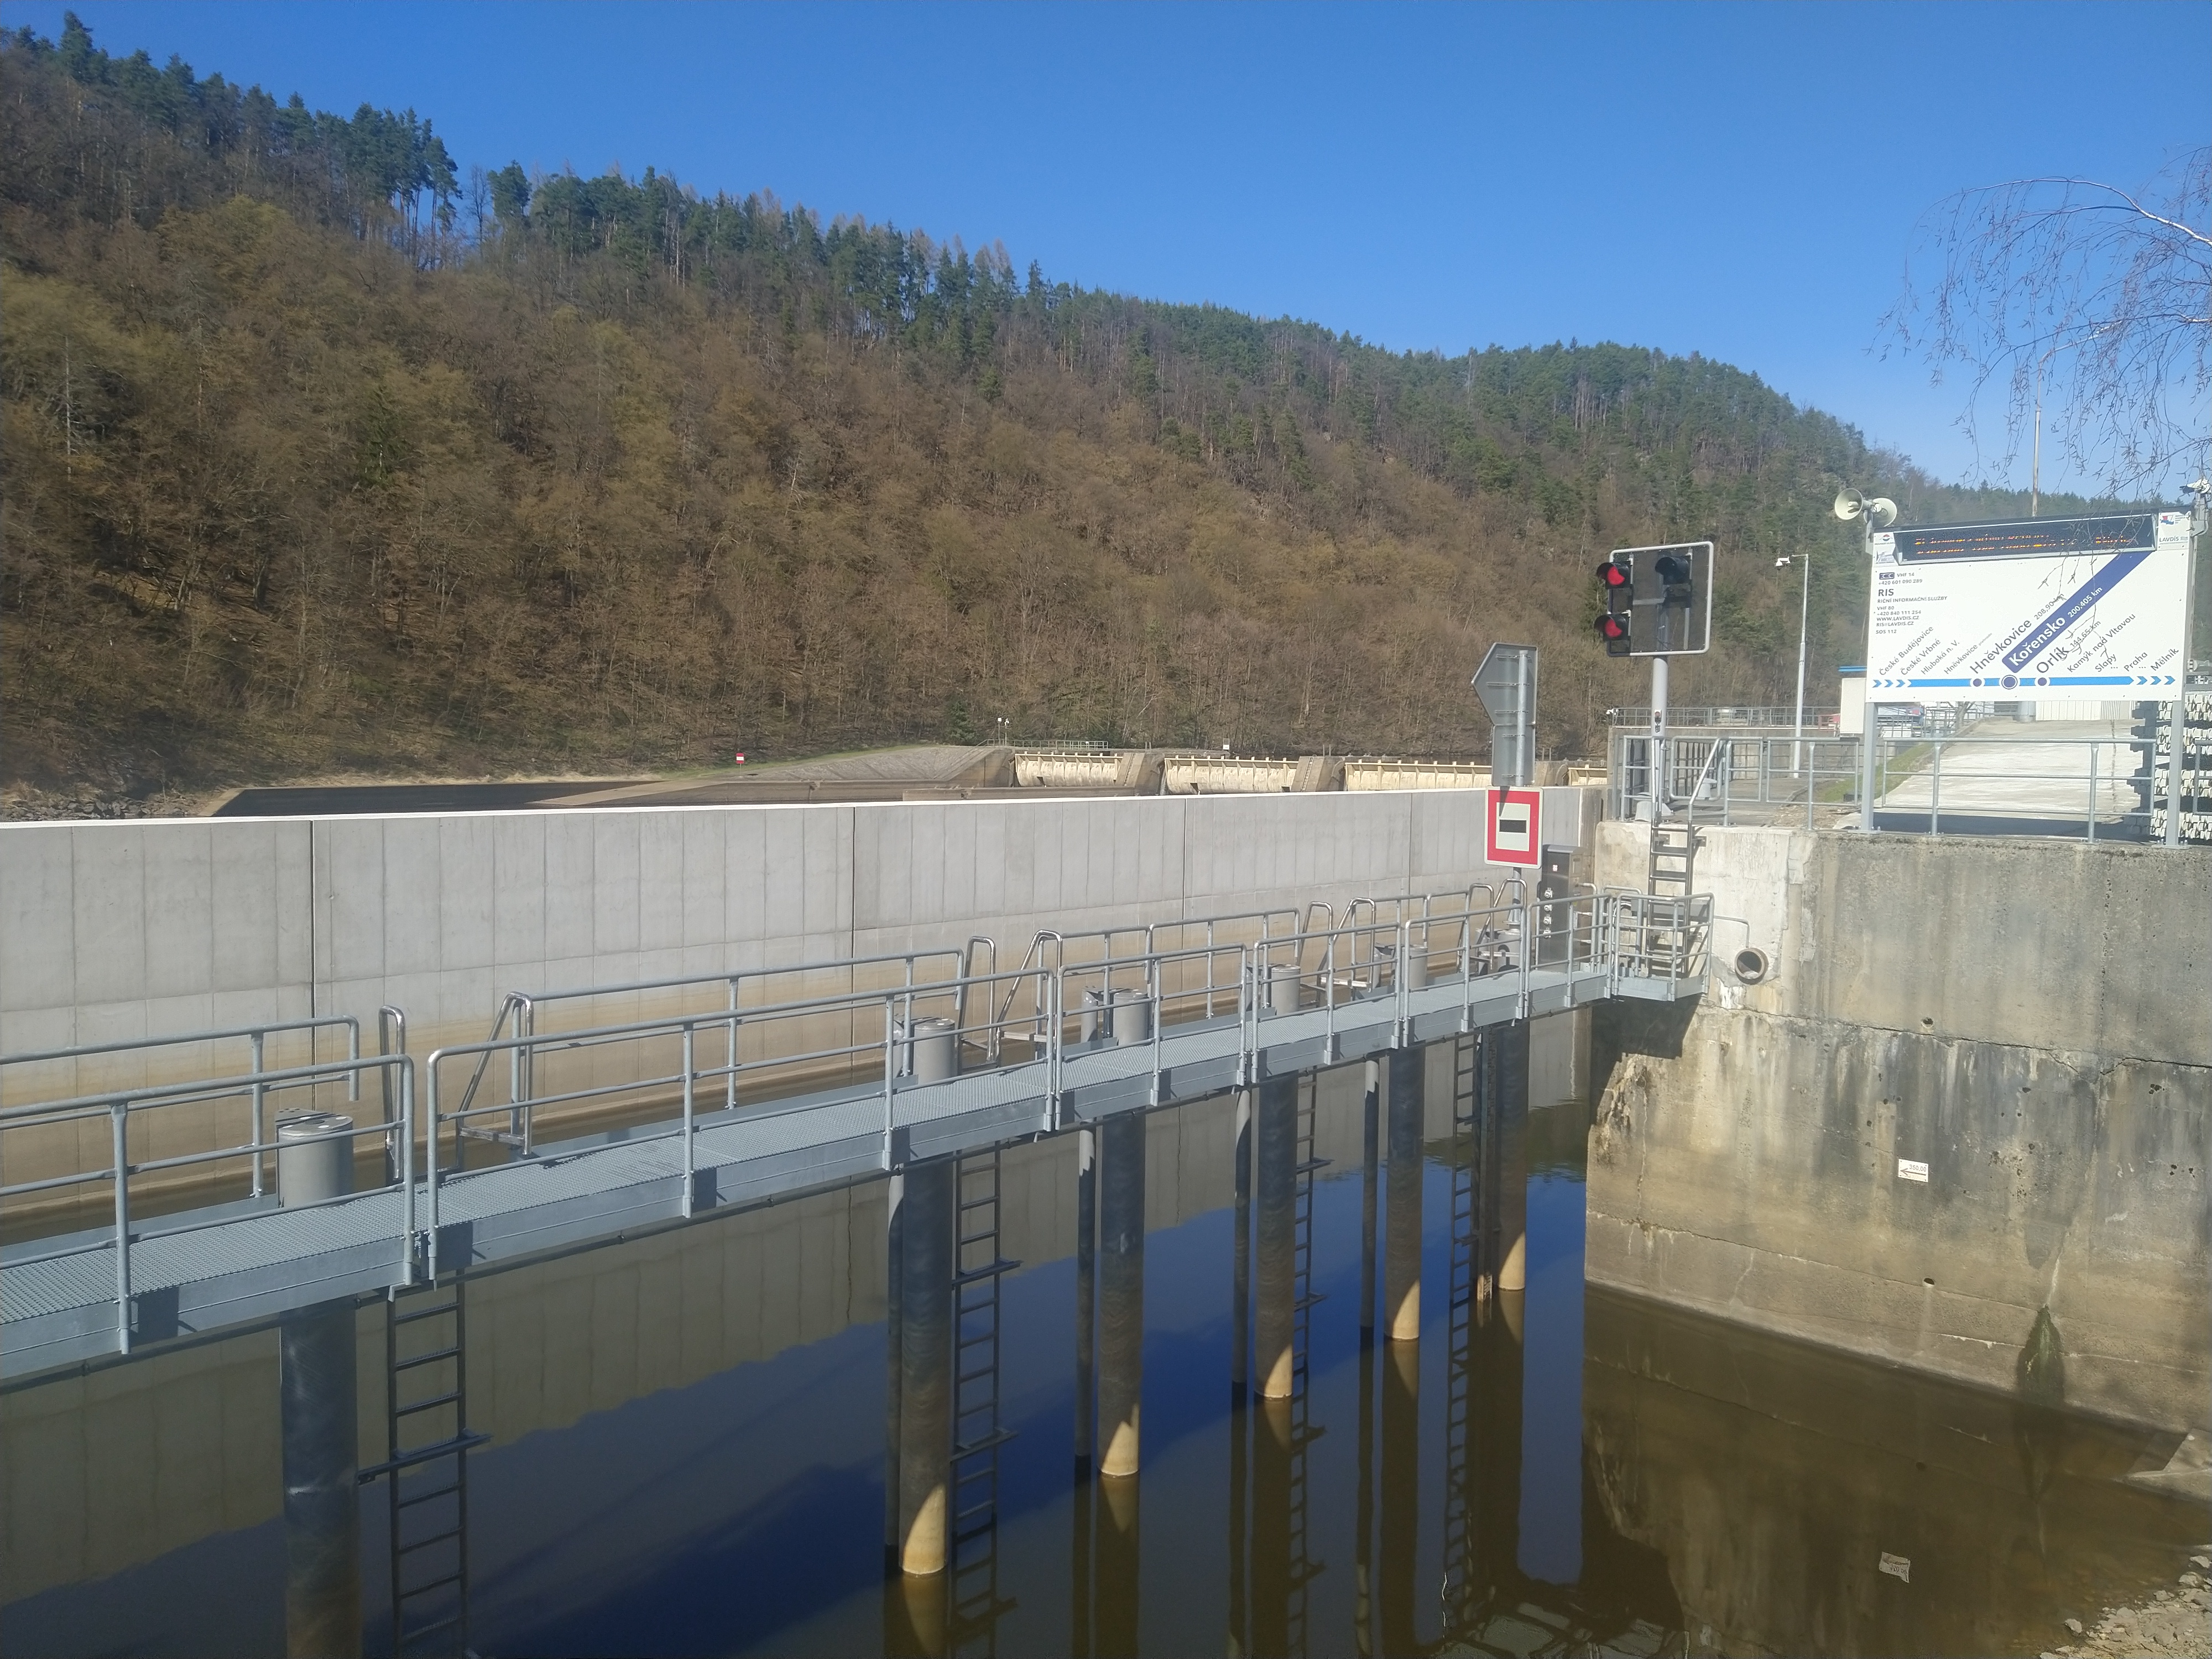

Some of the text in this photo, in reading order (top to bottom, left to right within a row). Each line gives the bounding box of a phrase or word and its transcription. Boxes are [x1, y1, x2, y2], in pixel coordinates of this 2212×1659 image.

[1878, 588, 1894, 597] RIS
[1970, 620, 2032, 674] Hněvkovice
[2033, 601, 2054, 620] 208,90
[2008, 617, 2065, 667] Kořensko
[2067, 595, 2093, 618] 200,405
[2090, 587, 2103, 597] km
[1880, 626, 1934, 676] České Budějovice
[1900, 638, 1941, 675] České Vrbné
[2067, 613, 2136, 672] Kamýk nad Vltavou
[1921, 650, 1947, 675] Hluboká
[2036, 646, 2069, 674] Orlík
[2095, 654, 2117, 673] Slapy
[2124, 651, 2148, 672] Praha
[2150, 647, 2179, 671] Mělník
